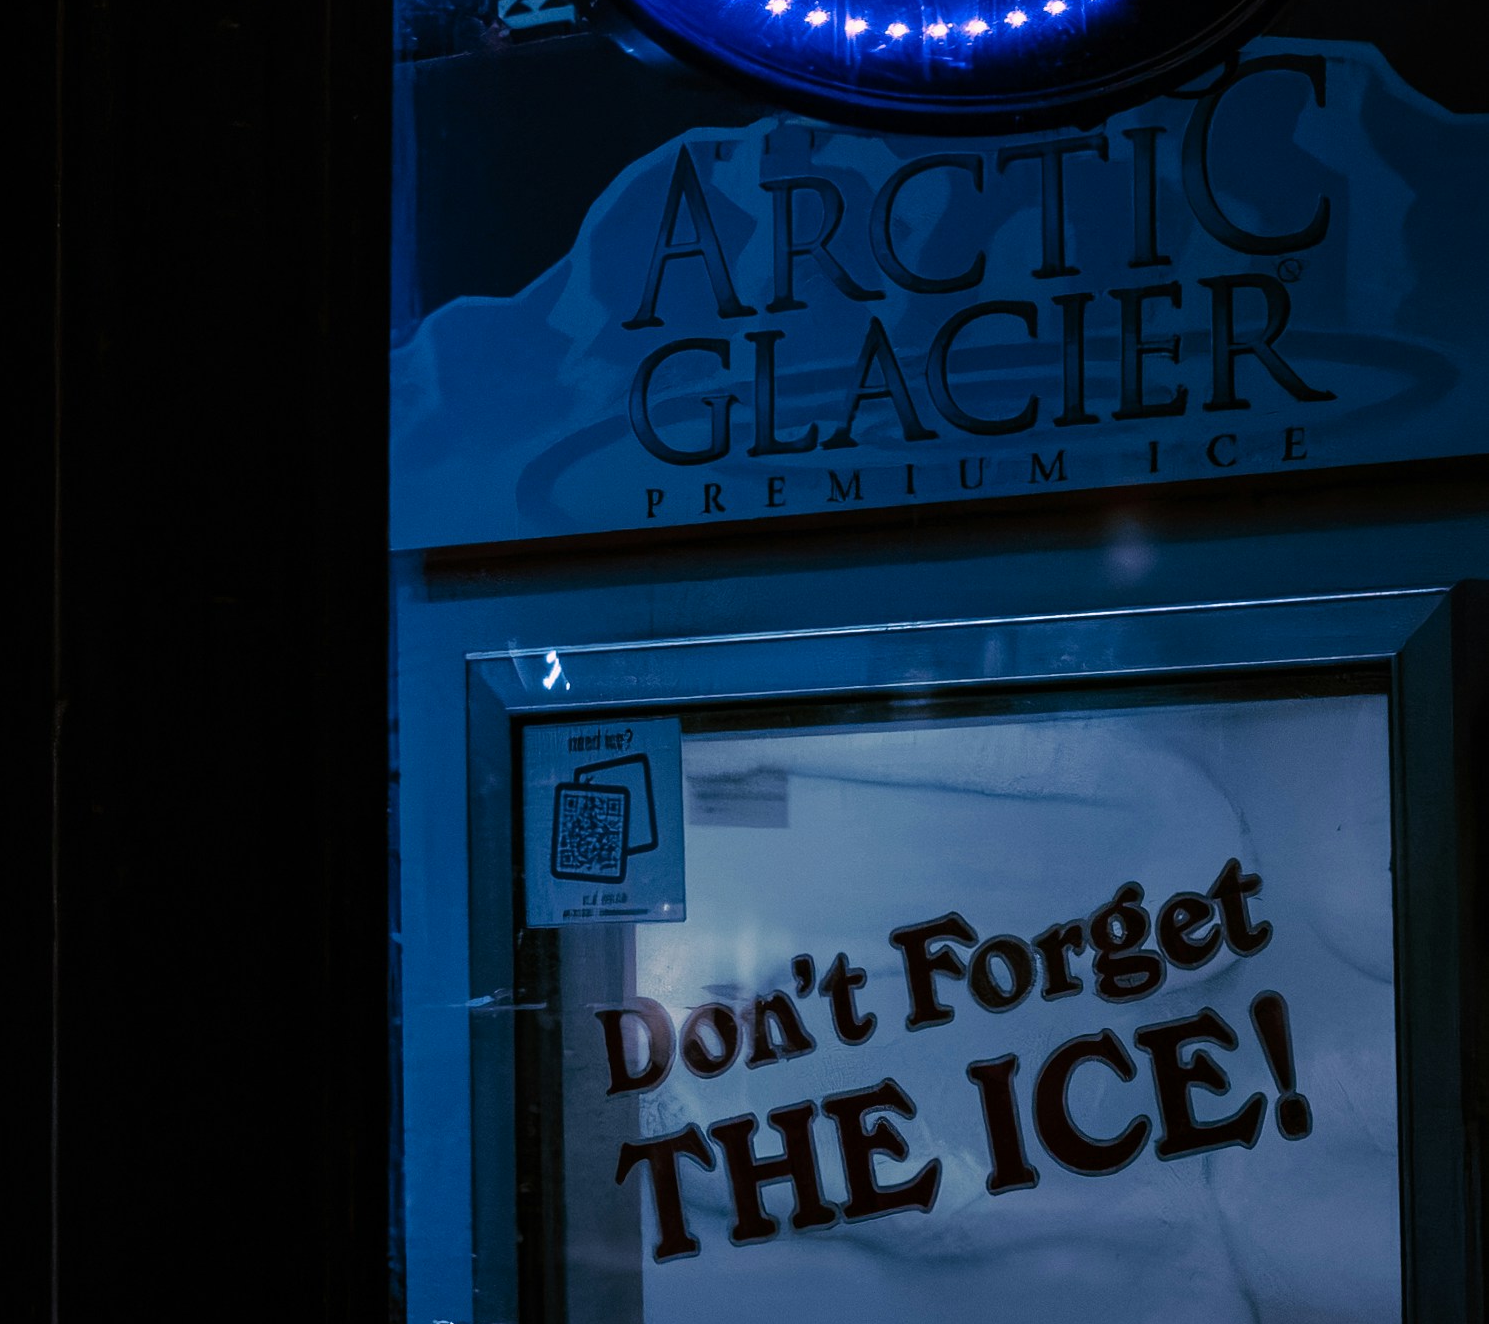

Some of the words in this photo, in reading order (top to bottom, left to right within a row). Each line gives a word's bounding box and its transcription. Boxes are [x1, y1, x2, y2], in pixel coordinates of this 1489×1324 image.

[623, 54, 1332, 330] ARCTIC
[628, 274, 1338, 466] GLACIER
[646, 450, 1069, 519] PREMIUM
[1149, 426, 1309, 474] ICE
[595, 952, 876, 1096] Don't
[890, 858, 1273, 1032] Forget
[615, 1078, 942, 1263] THE
[967, 991, 1312, 1195] ICE!
